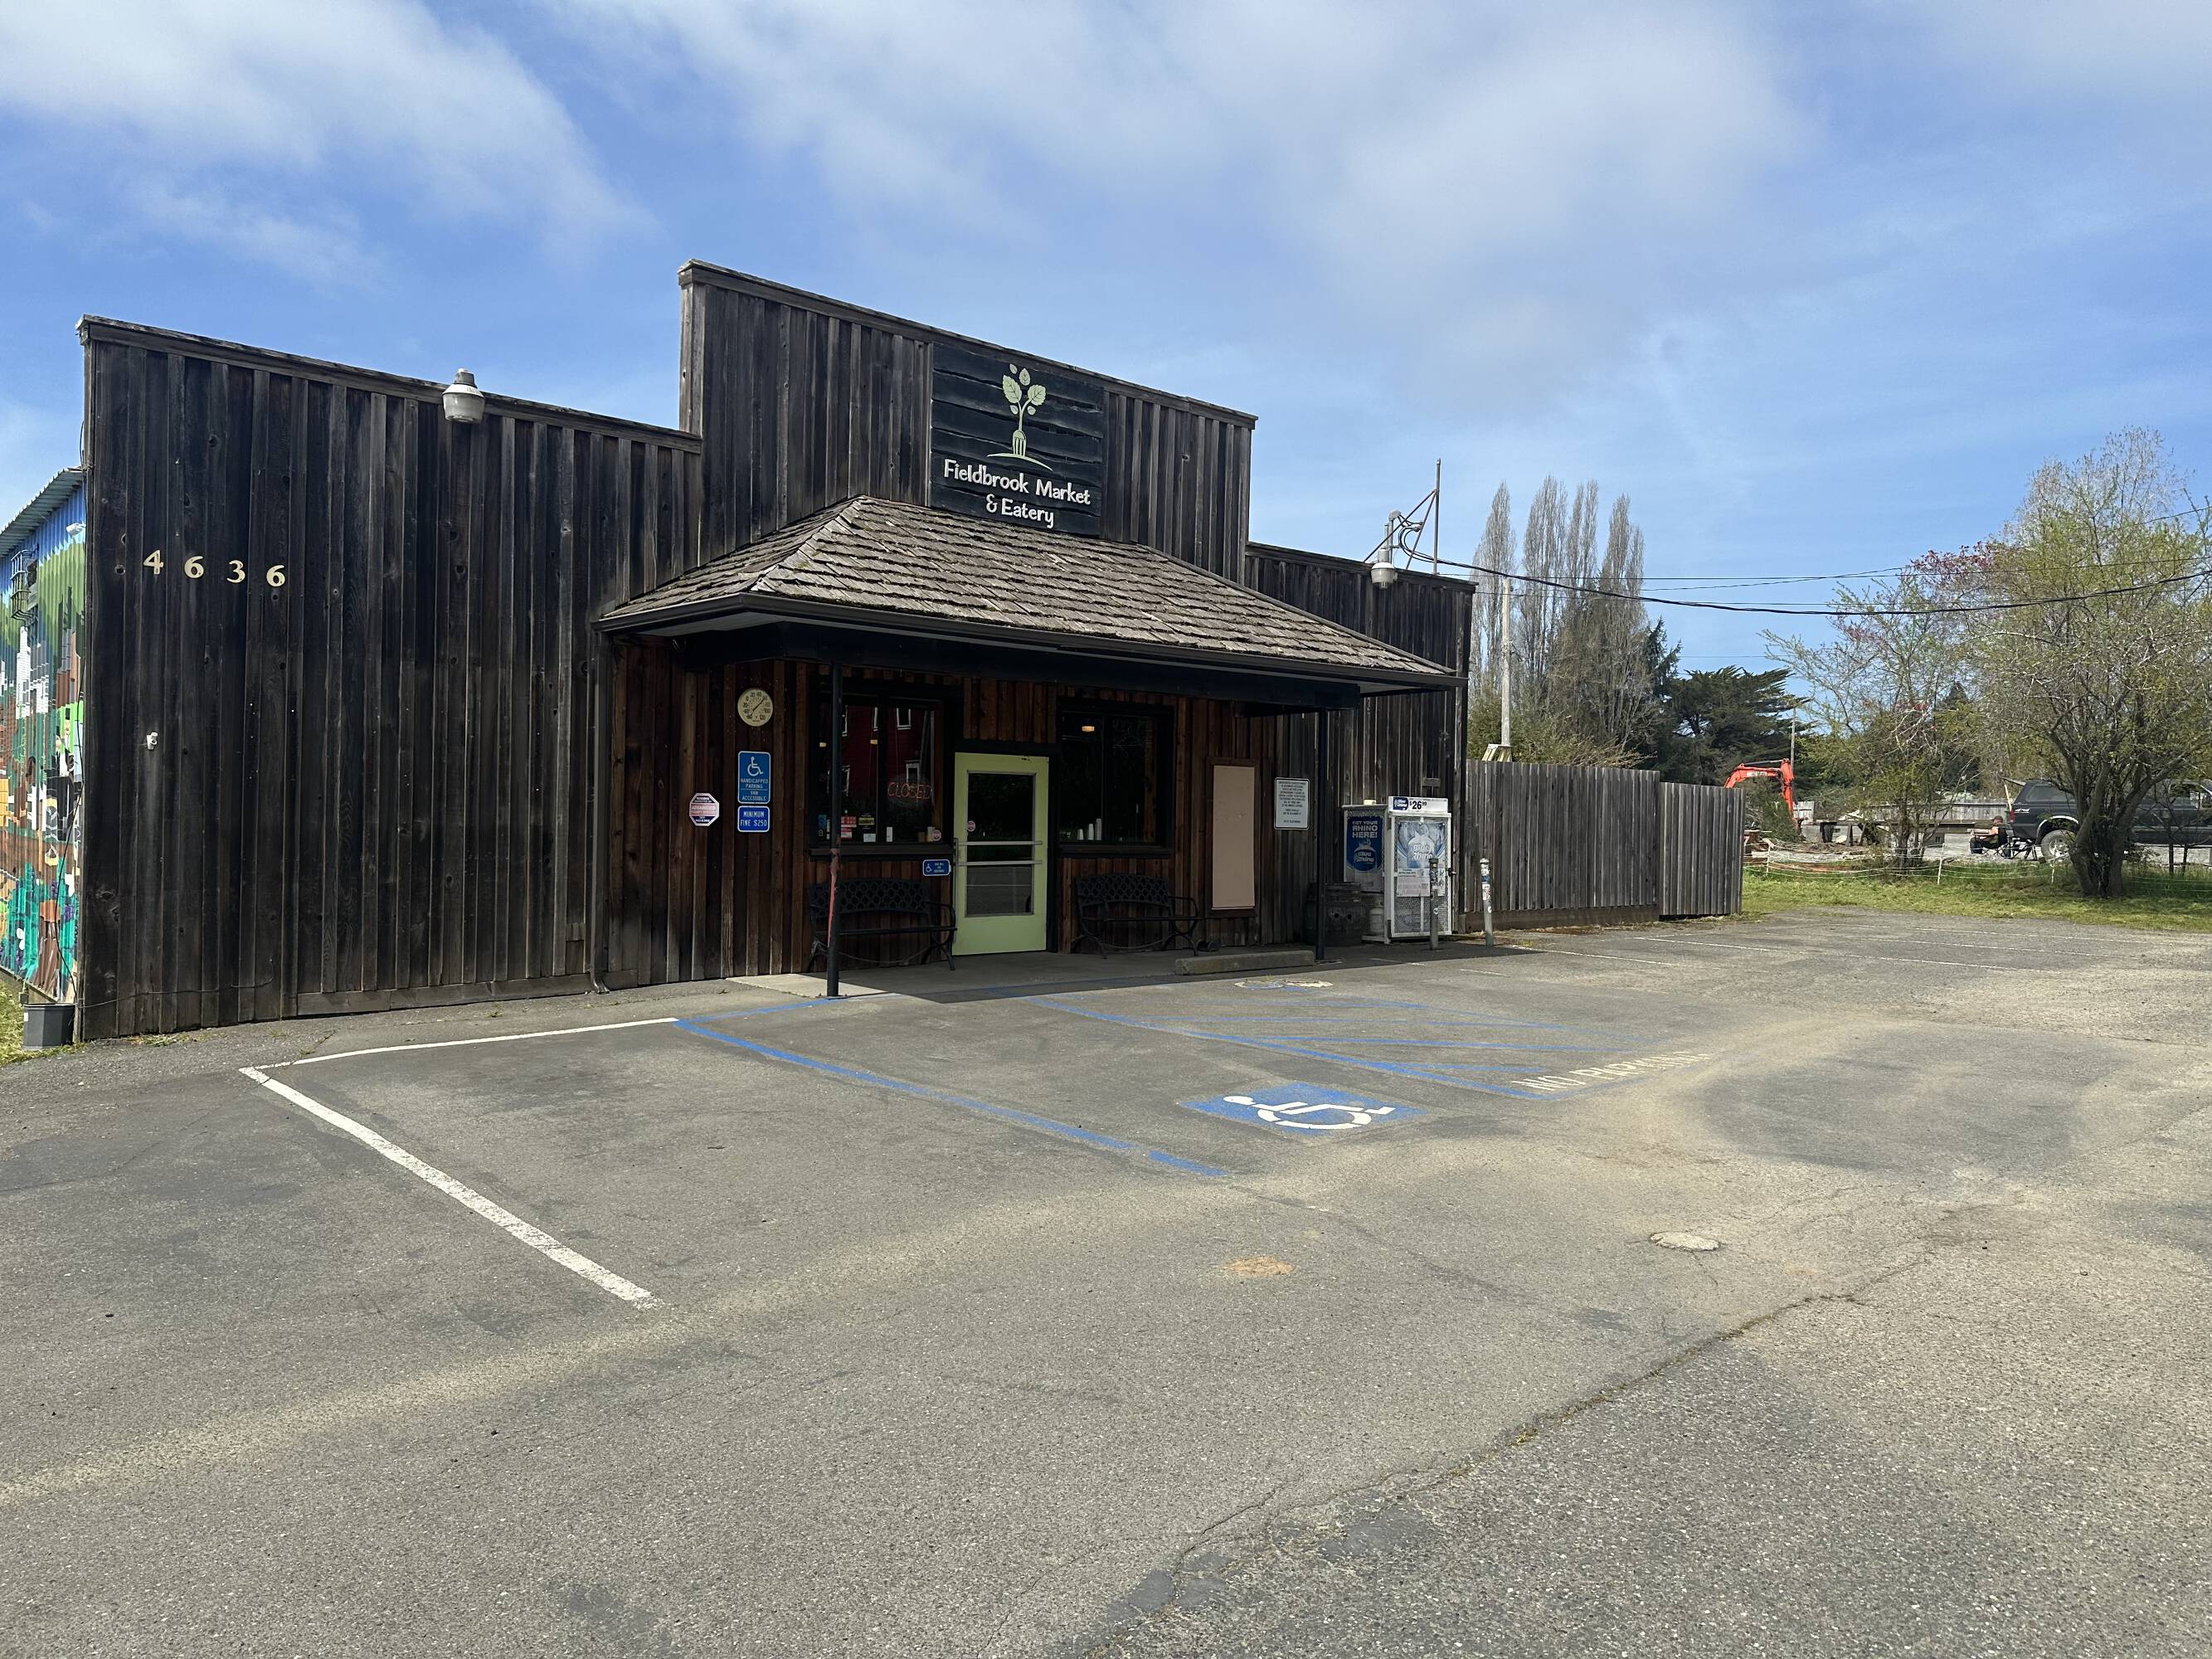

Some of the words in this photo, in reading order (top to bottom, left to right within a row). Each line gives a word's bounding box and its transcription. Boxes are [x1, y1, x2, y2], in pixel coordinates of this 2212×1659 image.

[944, 459, 1029, 494] Fieldbrook
[1035, 479, 1091, 505] Market
[985, 494, 998, 513] &
[1001, 498, 1054, 528] Eatery
[143, 549, 286, 587] 4636
[887, 781, 931, 800] CLOSED
[1511, 1075, 1586, 1091] NO
[1568, 1051, 1714, 1080] PARKING
